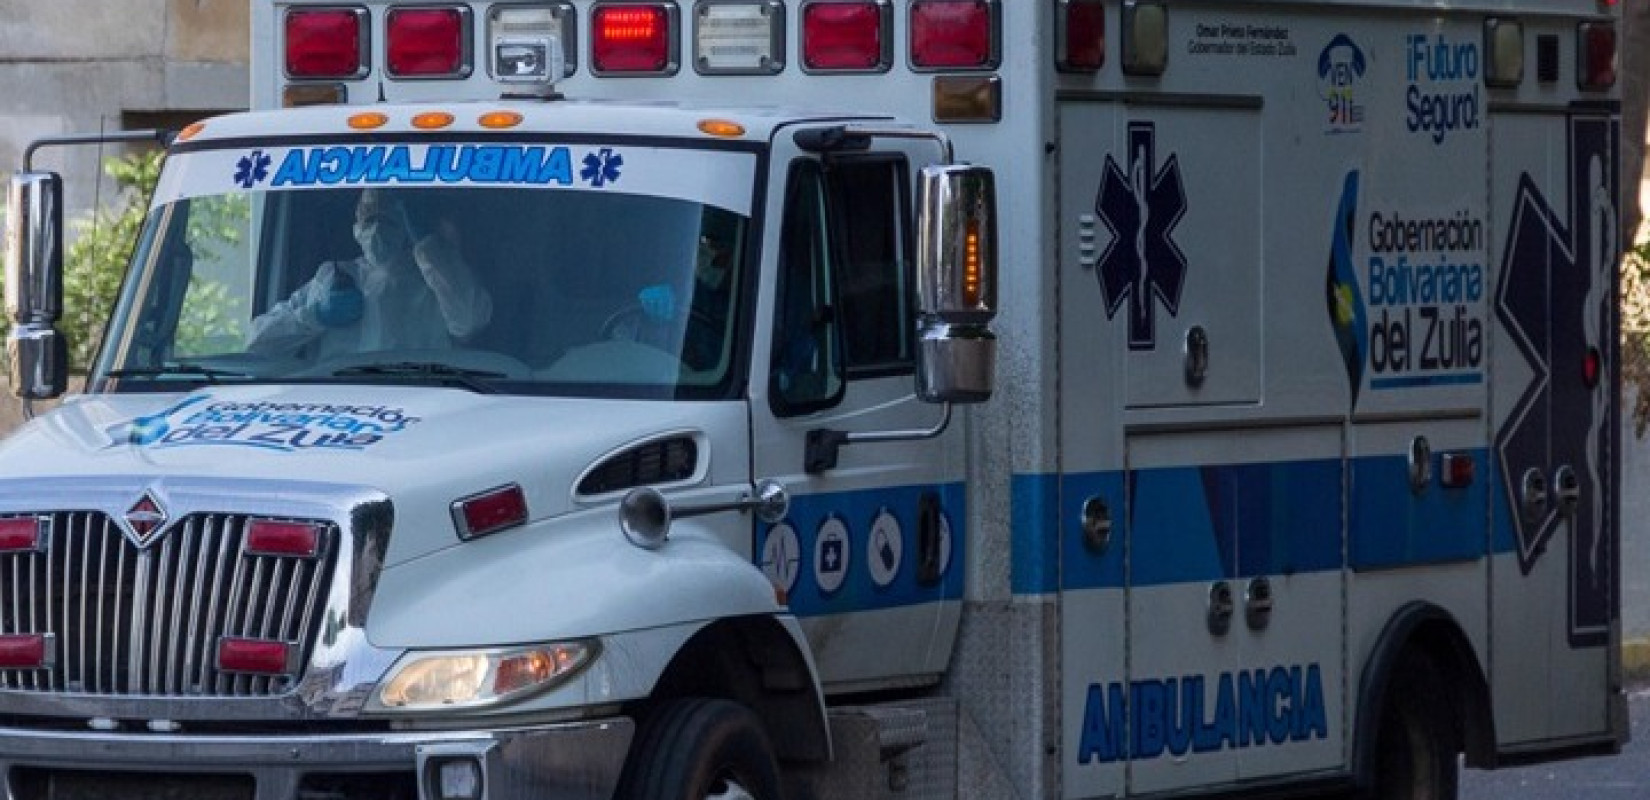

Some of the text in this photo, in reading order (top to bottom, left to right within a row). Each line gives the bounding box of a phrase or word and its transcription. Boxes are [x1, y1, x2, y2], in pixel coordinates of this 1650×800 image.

[1406, 84, 1479, 145] Seguro!
[1369, 211, 1483, 252] Gobernación
[1368, 255, 1482, 306] Bolivariana
[1371, 305, 1482, 372] del Zulia
[1077, 662, 1328, 766] AMBULANCIA
